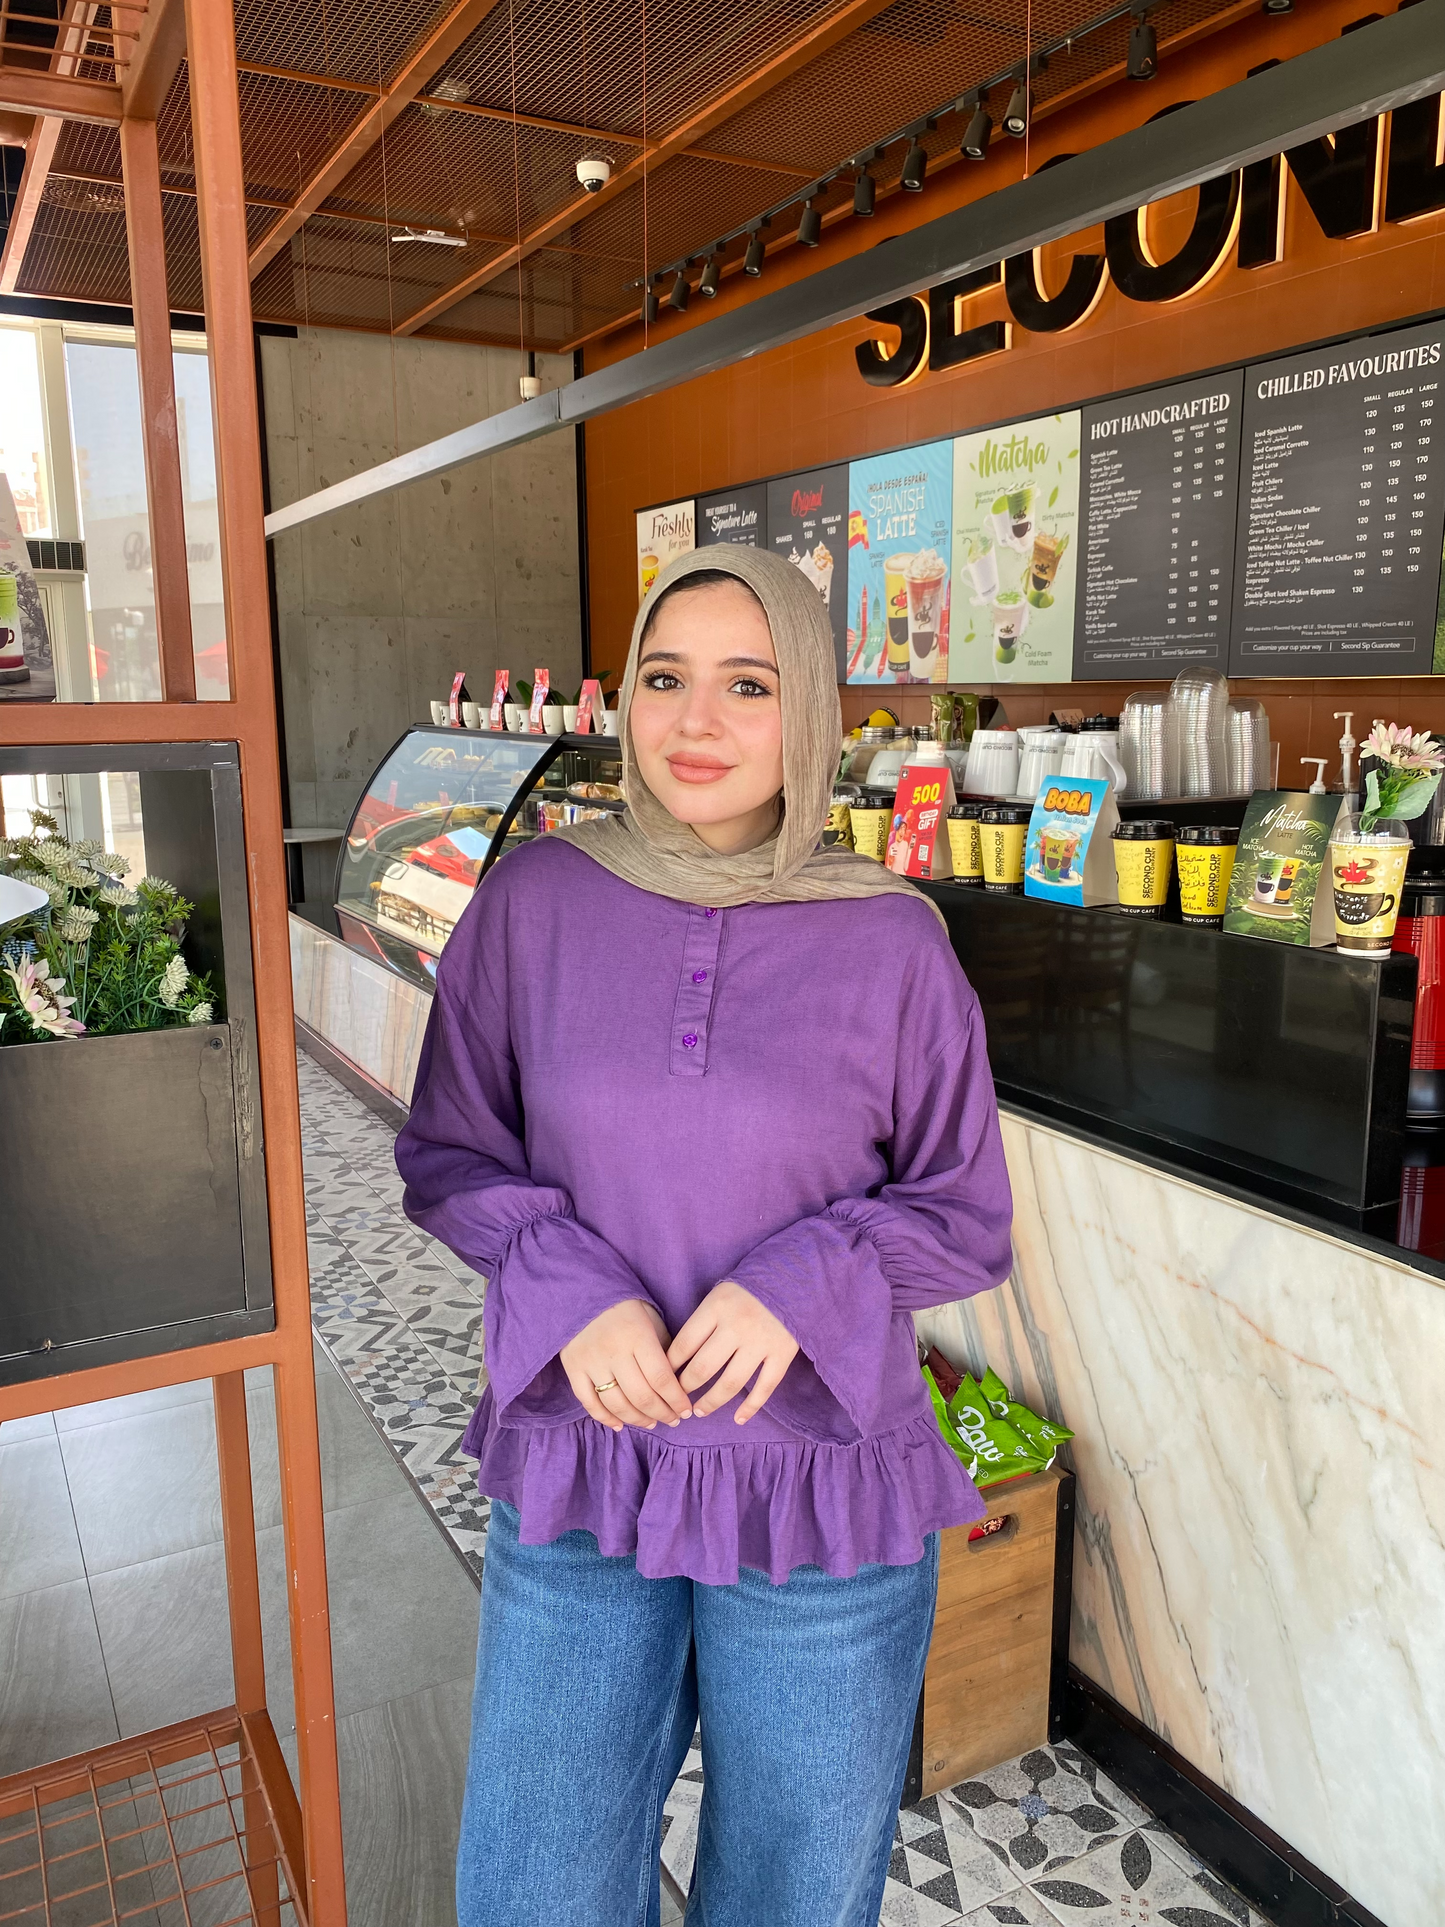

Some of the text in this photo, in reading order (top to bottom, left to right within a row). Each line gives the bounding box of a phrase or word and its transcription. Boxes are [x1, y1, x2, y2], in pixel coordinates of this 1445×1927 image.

[1257, 342, 1441, 399] CHILLED FAVOURITES
[1388, 388, 1413, 397] REGULAR
[1419, 383, 1438, 392] LARGE
[1091, 393, 1230, 440] HOT HANDCRAFTED
[1394, 405, 1405, 413] 135
[1421, 400, 1433, 408] 150
[1392, 423, 1403, 431] 150
[1420, 418, 1431, 426] 170
[1418, 437, 1430, 445] 130
[979, 434, 1050, 479] Matcha
[884, 478, 902, 490] DESDE
[791, 484, 824, 517] Original
[870, 487, 925, 518] SPANISH
[1413, 492, 1425, 500] 160
[652, 512, 692, 539] Freshly
[711, 510, 758, 536] Signature Latte
[802, 515, 841, 528] SMALL REGULAR
[877, 513, 916, 541] LATTE
[669, 539, 690, 551] for you
[775, 534, 792, 543] SHAKES
[1372, 641, 1401, 649] Guarantee
[912, 783, 940, 805] 500
[1044, 788, 1092, 816] BOBA
[918, 818, 937, 830] GIFT
[1260, 804, 1307, 838] Matcha
[1295, 849, 1317, 857] MATCHA
[1142, 865, 1151, 899] SECOND
[1207, 854, 1217, 908] SECOND CUP
